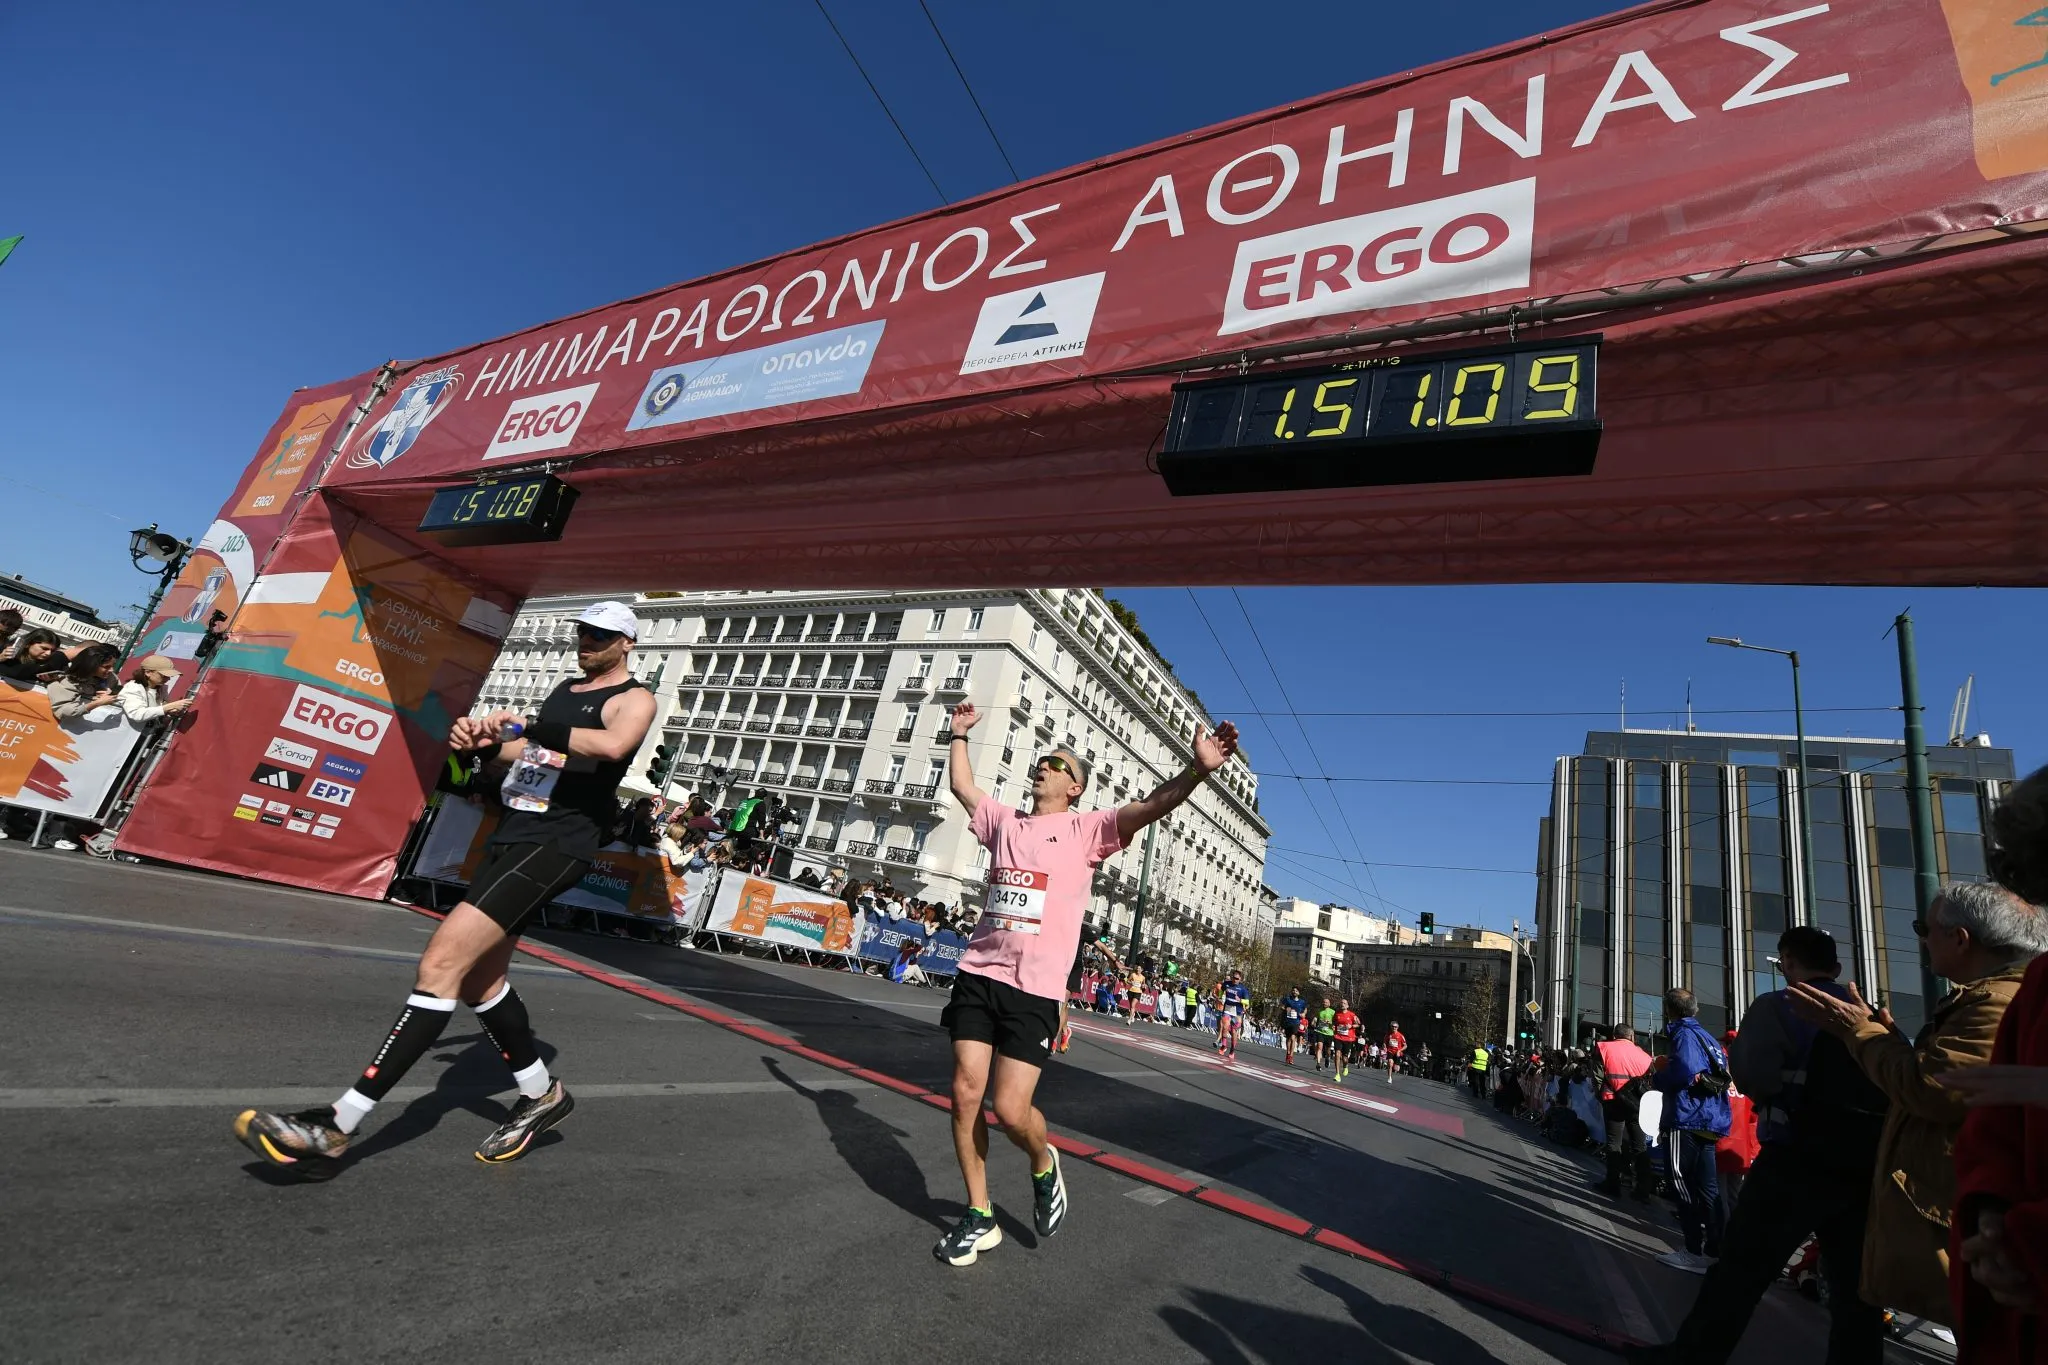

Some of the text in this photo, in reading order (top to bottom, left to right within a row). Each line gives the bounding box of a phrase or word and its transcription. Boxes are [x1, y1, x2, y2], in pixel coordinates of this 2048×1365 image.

[465, 4, 1850, 400] ΗΜΙΜΑΡΑΘΩΝΙΟΣ ΑΘΗΝΑΣ
[1244, 212, 1510, 311] ERGO
[963, 341, 1085, 369] ΠΕΡΙΦΕΡΕΙΑ ΑΤΤΙΚΗΣ
[688, 373, 728, 389] ΔΗΜΟΣ
[497, 401, 582, 444] ERGO
[253, 495, 275, 508] ERGO
[220, 534, 247, 553] 2025
[381, 598, 443, 631] ΑΘΗΝΑΣ
[362, 632, 428, 665] ΜΑΡΑΘΩΝΙΟΣ
[335, 658, 384, 686] ERGO
[293, 696, 379, 741] ERGO
[325, 760, 356, 774] AEGEAN
[311, 782, 351, 803] ΕΡΤ
[997, 869, 1034, 887] ERGO
[995, 890, 1028, 907] 3479
[772, 913, 825, 933] ΗΜΙΜΑΡΑΘΩΝΙΟΣ
[789, 906, 816, 920] ΑΘΗΝΑΣ
[742, 923, 755, 931] ERGO
[1140, 993, 1155, 1006] ERGO
